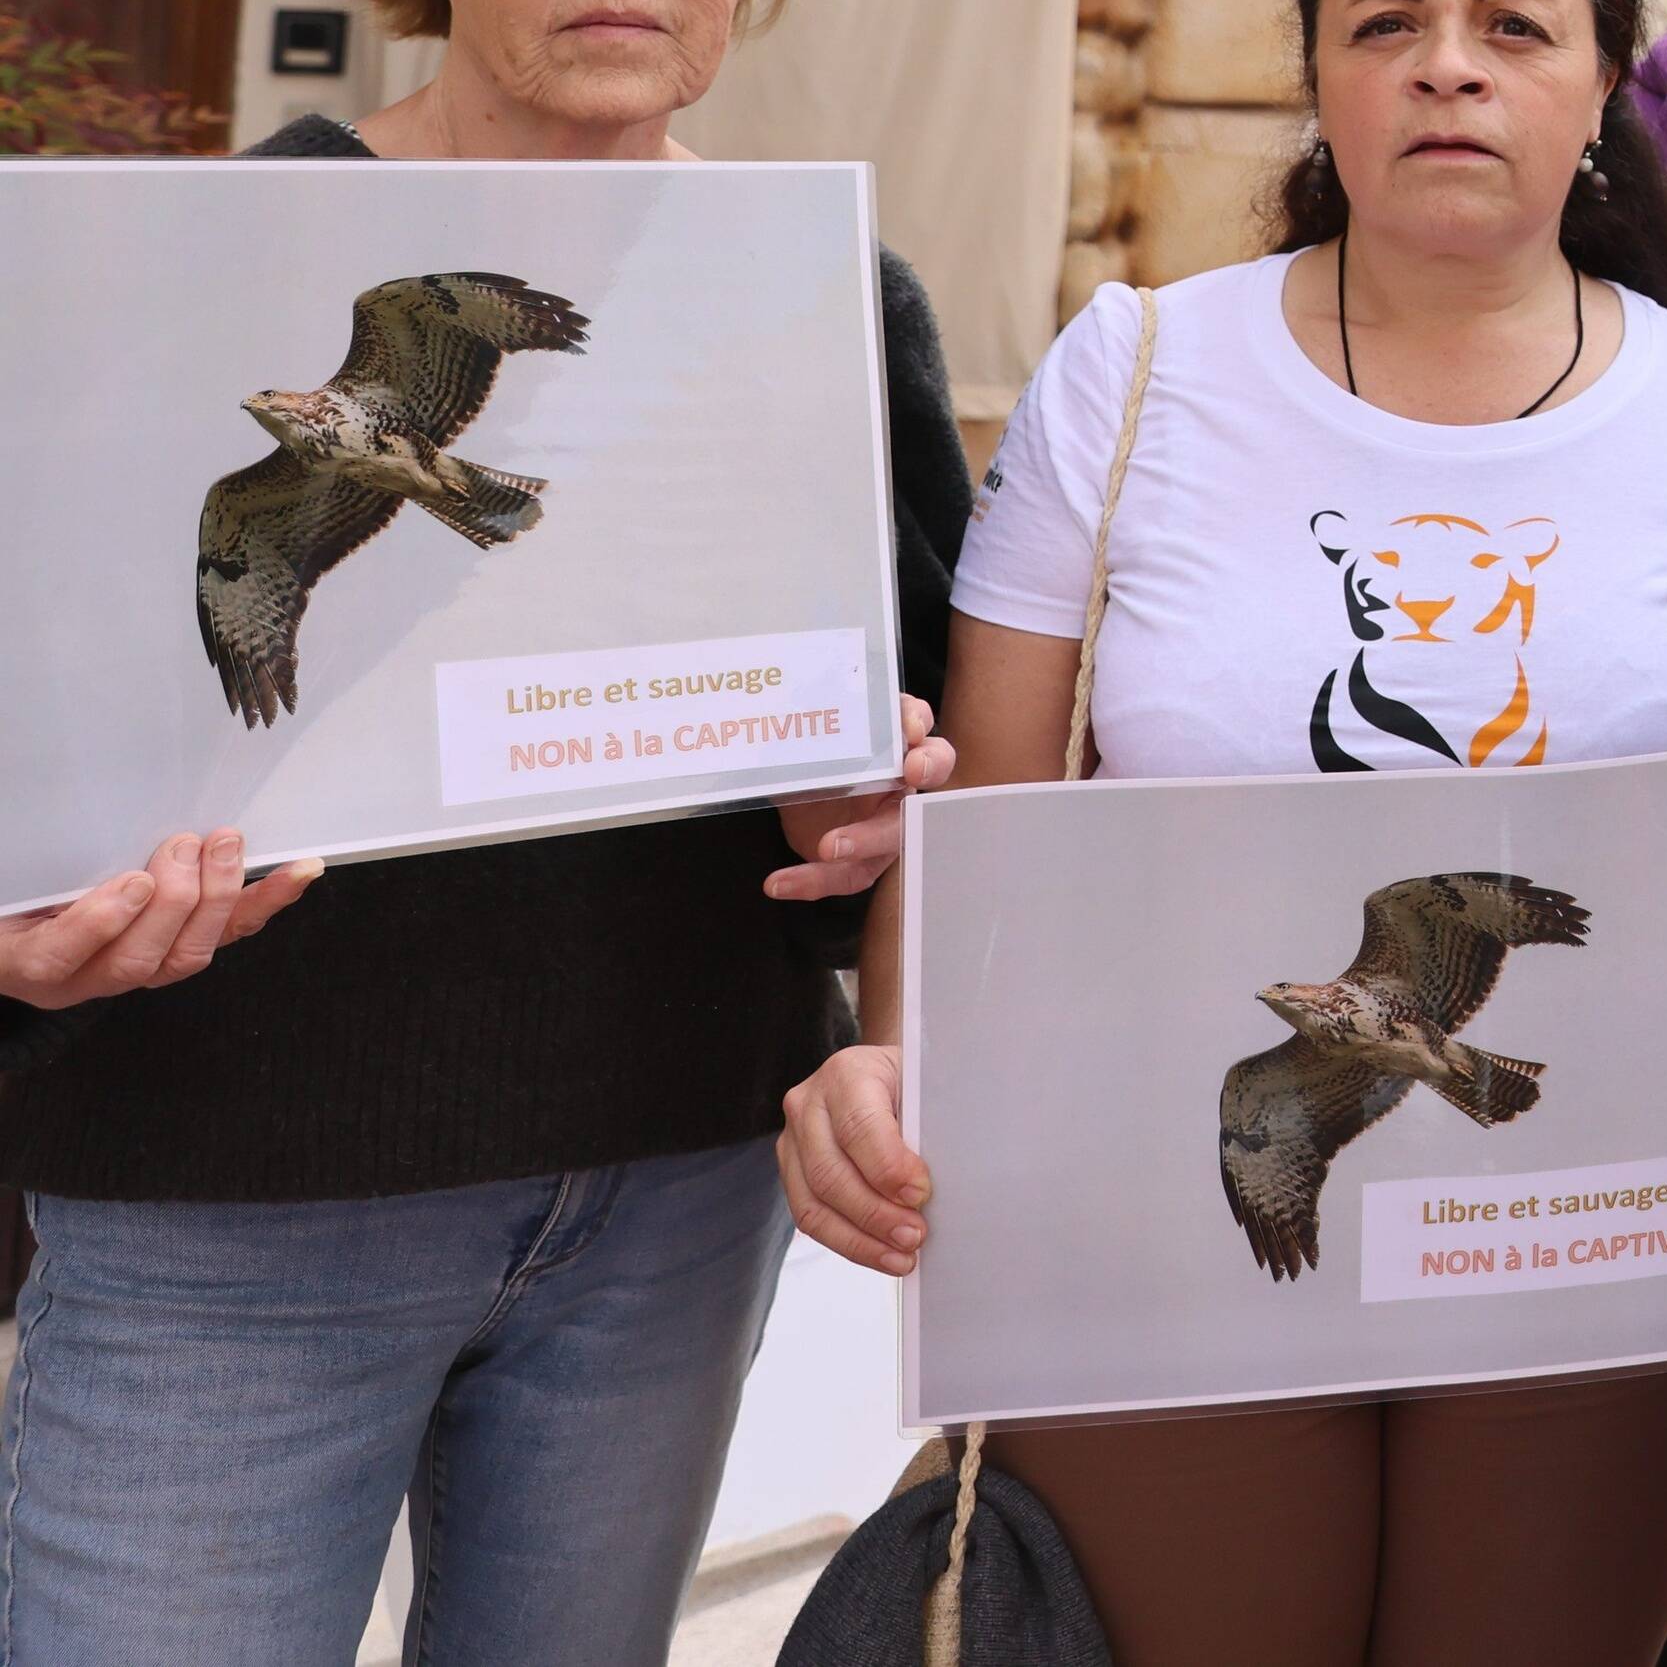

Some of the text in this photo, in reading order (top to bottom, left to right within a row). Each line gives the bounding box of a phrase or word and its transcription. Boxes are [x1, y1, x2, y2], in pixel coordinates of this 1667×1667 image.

[507, 667, 781, 714] Libre et sauvage
[510, 709, 840, 772] NON à la CAPTIVITE
[1423, 1199, 1498, 1224] Libre
[1509, 1196, 1539, 1219] et
[1422, 1249, 1494, 1276] NON
[1504, 1246, 1521, 1271] à
[1532, 1243, 1557, 1268] la
